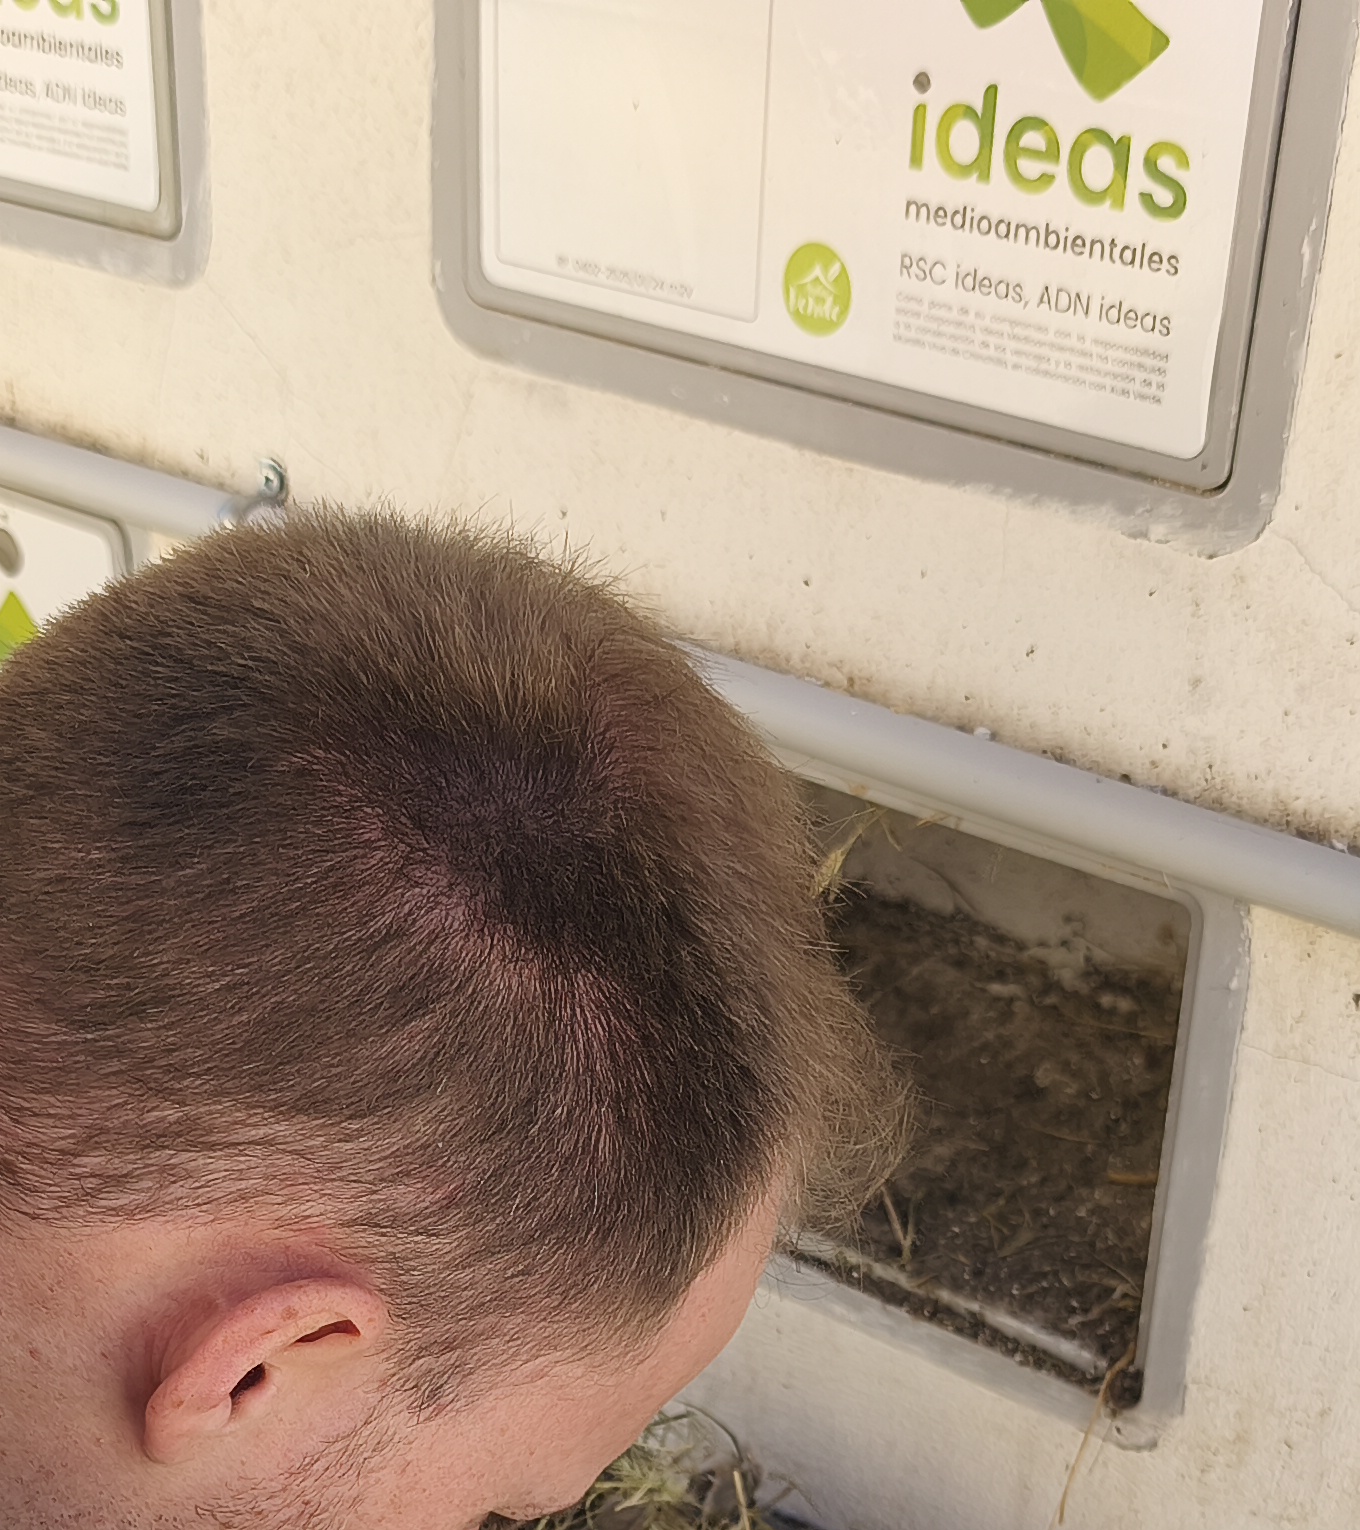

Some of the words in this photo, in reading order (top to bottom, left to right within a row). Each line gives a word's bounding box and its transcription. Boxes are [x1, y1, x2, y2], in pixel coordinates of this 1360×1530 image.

[908, 71, 1190, 222] ideas
[905, 198, 1181, 277] medioambientales
[900, 252, 947, 287] RSC
[955, 264, 1031, 310] ideas,
[1036, 285, 1091, 320] ADN
[1098, 295, 1172, 338] ideas
